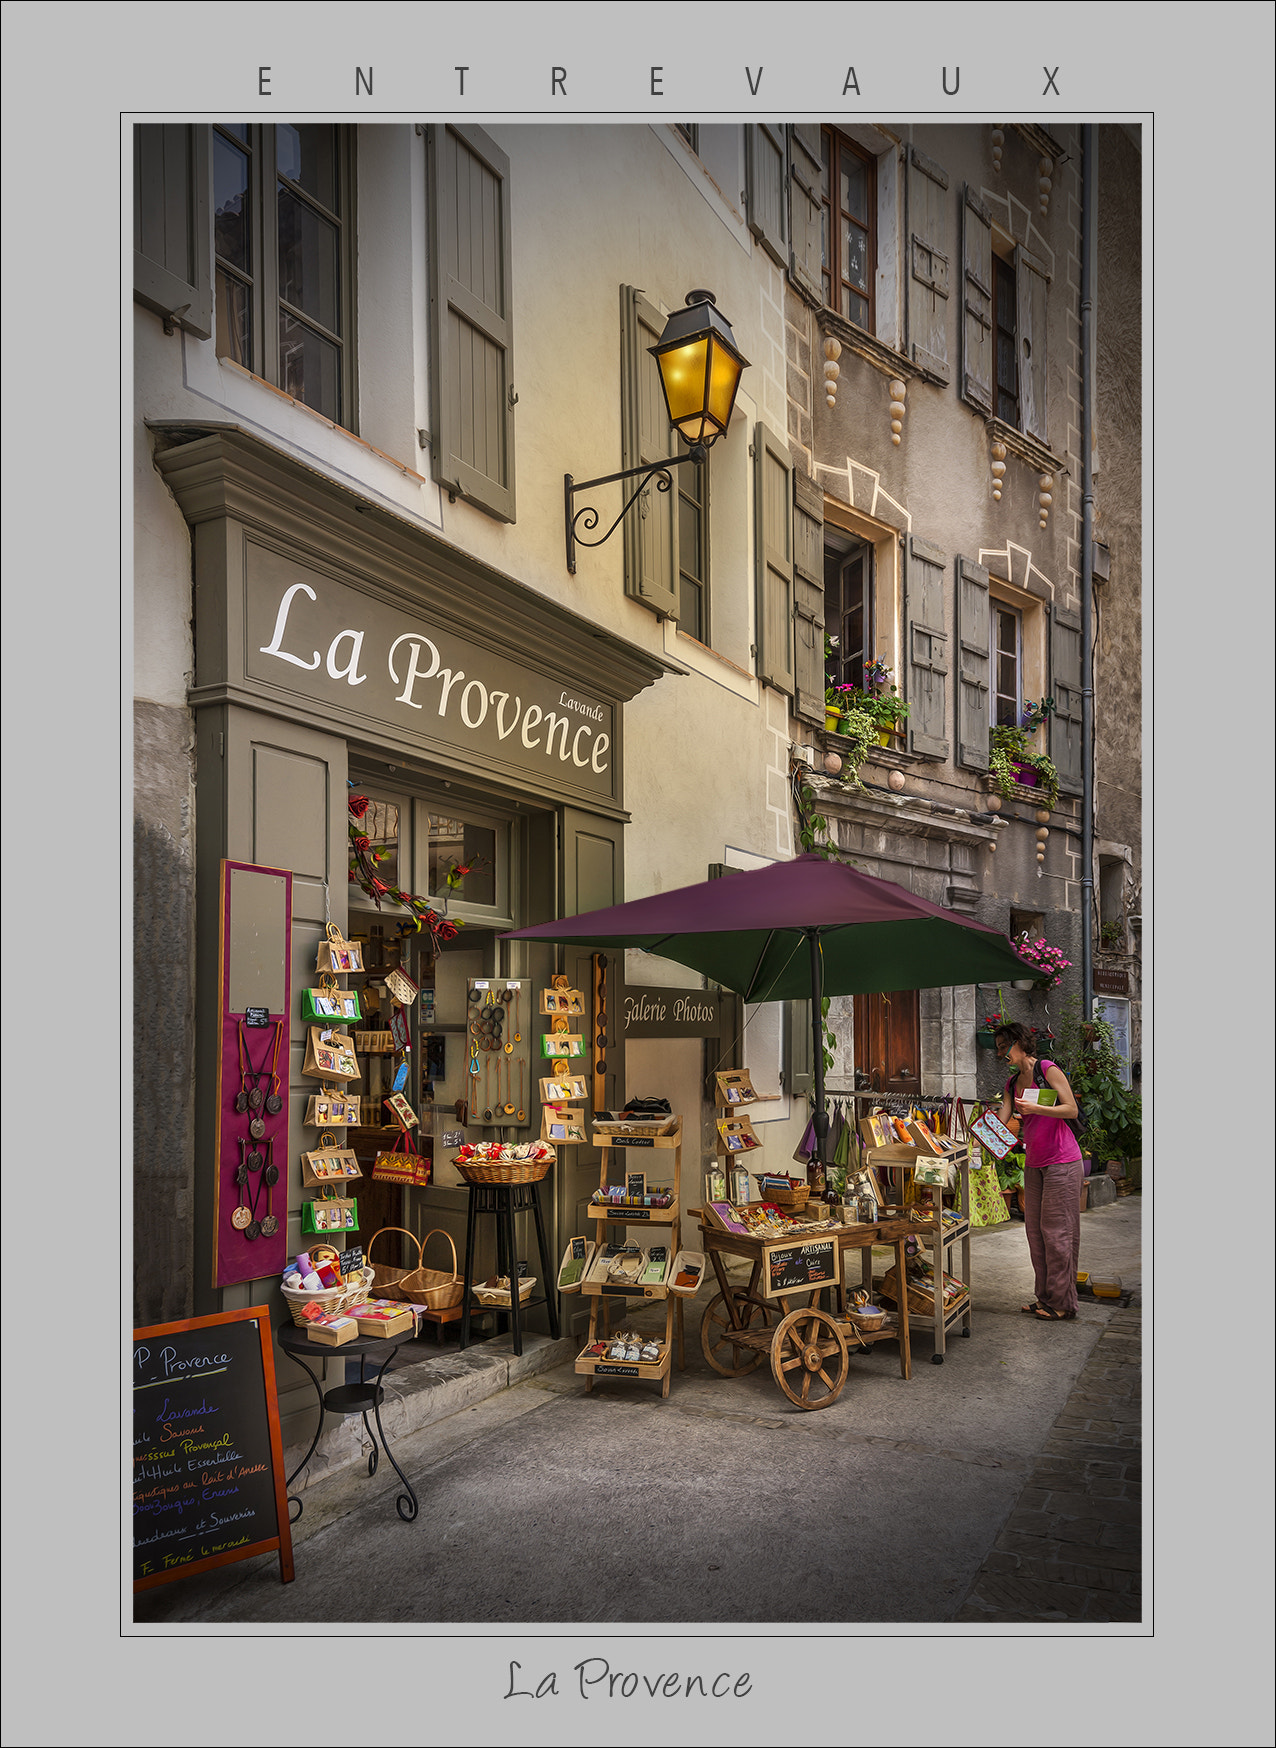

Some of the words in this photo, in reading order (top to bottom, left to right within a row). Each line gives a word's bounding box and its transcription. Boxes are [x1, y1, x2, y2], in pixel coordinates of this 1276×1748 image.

[260, 583, 367, 686] La
[388, 633, 610, 774] Provence
[558, 691, 604, 722] Lavande
[624, 994, 667, 1031] Galerie
[673, 996, 714, 1022] Photos
[801, 1243, 832, 1254] ARTISANAL
[160, 1346, 233, 1376] Provence
[156, 1398, 220, 1422] Lavande
[180, 1432, 234, 1456] Provençal
[201, 1471, 225, 1487] lait
[195, 1518, 207, 1530] et
[162, 1549, 194, 1568] Fermé
